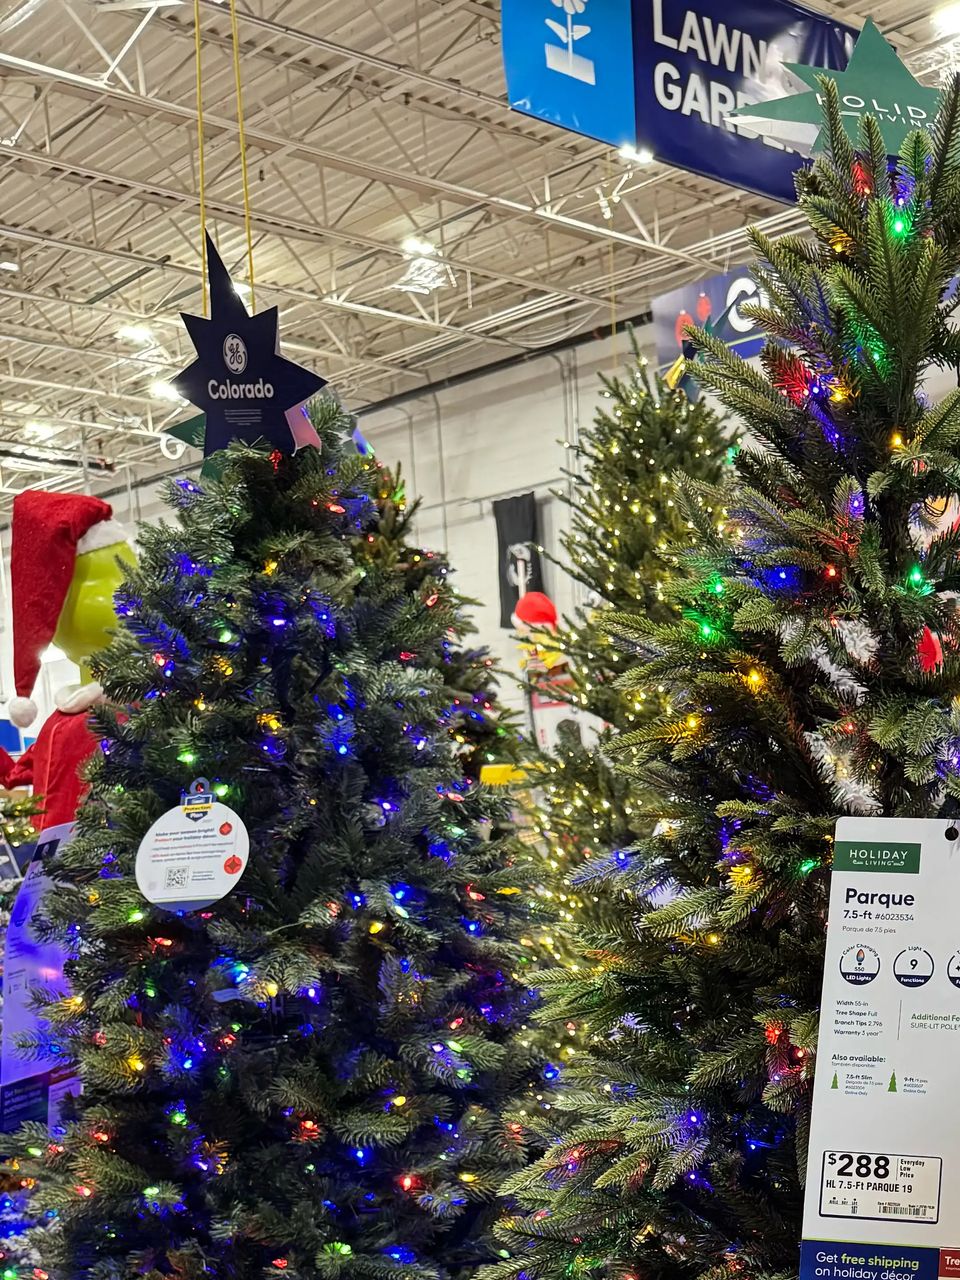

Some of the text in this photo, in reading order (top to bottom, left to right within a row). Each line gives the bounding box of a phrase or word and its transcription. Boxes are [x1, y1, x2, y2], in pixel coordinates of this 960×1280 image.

[208, 378, 274, 399] Colorado
[849, 849, 908, 860] HOLIDAY
[845, 887, 915, 909] Parque
[843, 909, 914, 922] 7.5-ft #6023534
[842, 925, 864, 933] Parque
[884, 927, 897, 935] pies
[910, 958, 918, 970] 9
[911, 1013, 951, 1022] Additional
[910, 1022, 939, 1030] SURE-LIT
[831, 1053, 887, 1063] Also available:
[828, 1153, 890, 1179] $288
[900, 1158, 925, 1167] Everyday
[826, 1179, 913, 1194] HL 7.5-Ft PARQUE 19
[816, 1251, 919, 1271] Get free shipping
[815, 1267, 830, 1276] on
